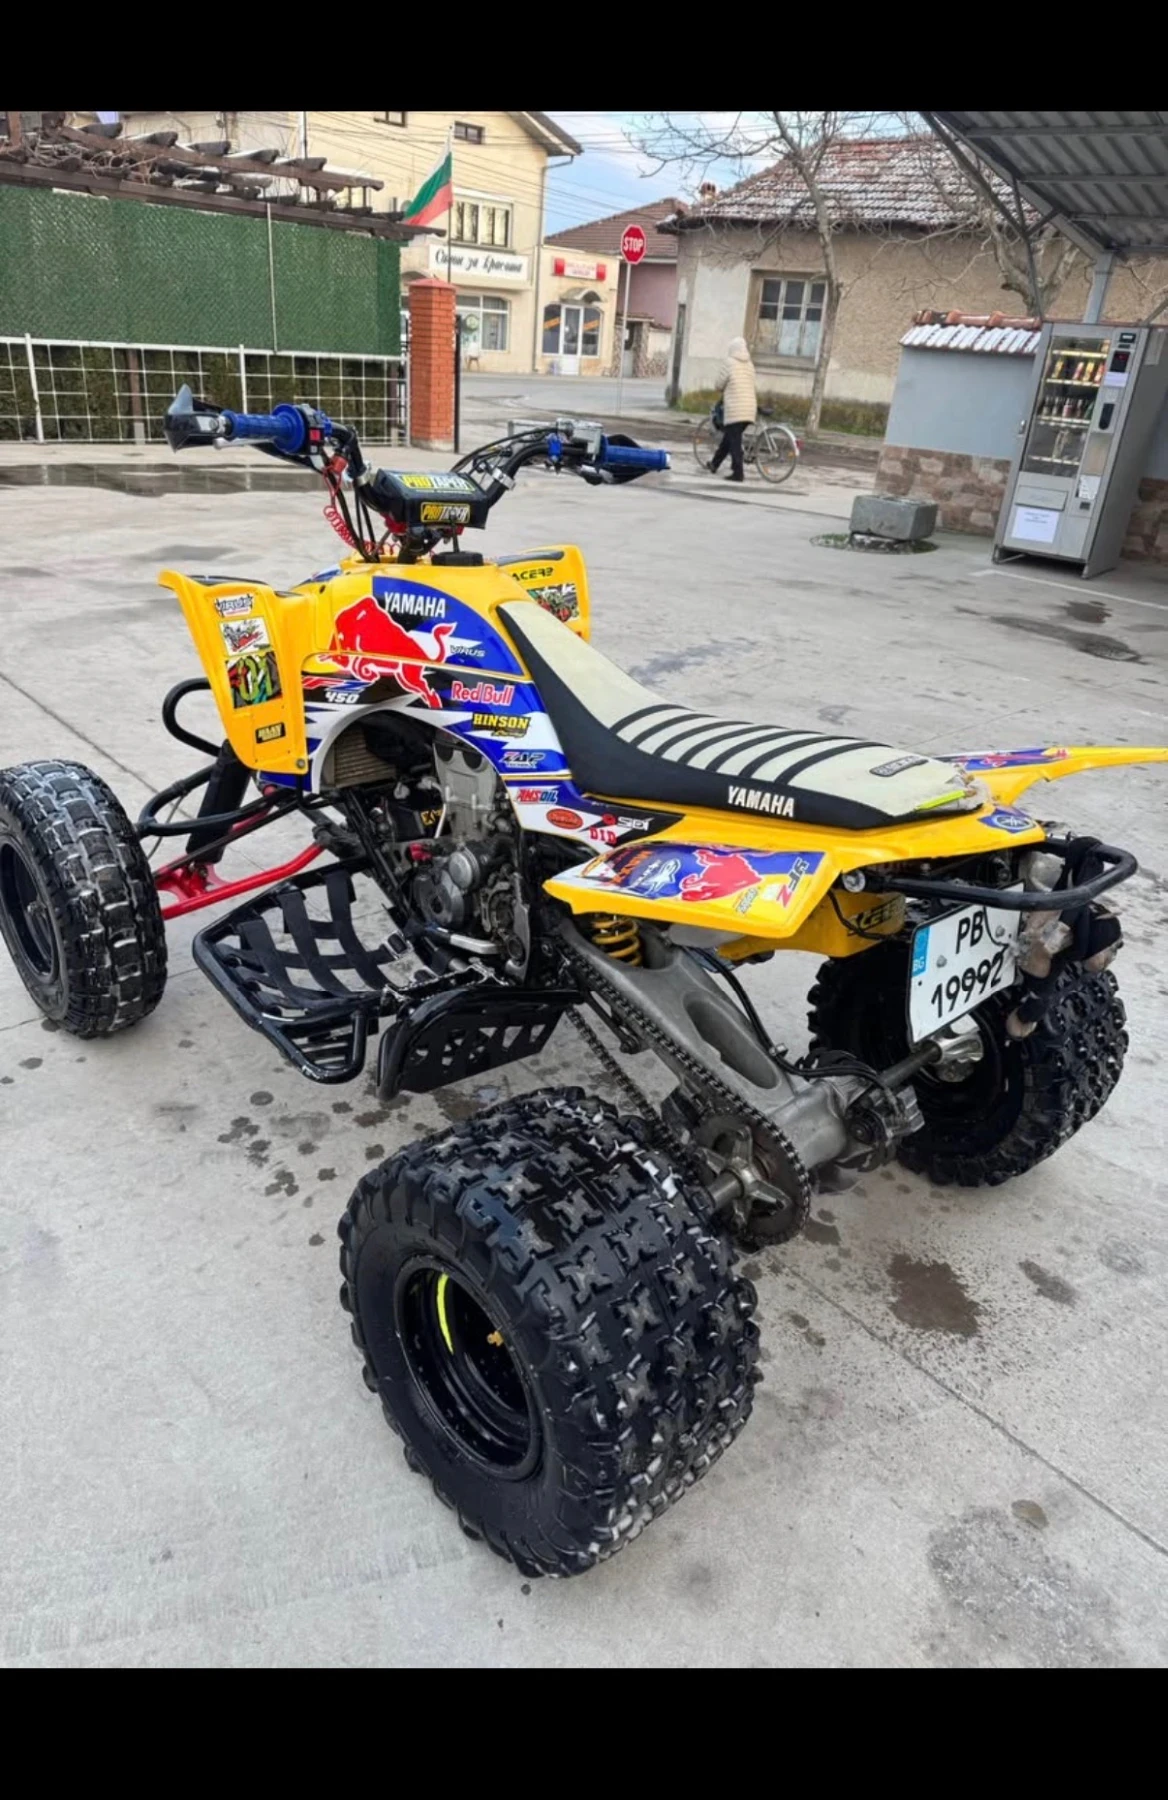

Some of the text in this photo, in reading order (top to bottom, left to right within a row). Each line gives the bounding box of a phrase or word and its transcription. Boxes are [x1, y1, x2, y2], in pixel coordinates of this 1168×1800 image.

[624, 237, 643, 252] STOP
[384, 592, 446, 618] YAMAHA
[325, 690, 359, 703] 450
[452, 681, 515, 706] Red Bull
[473, 713, 529, 729] HINSON
[517, 789, 558, 804] AMSOIL
[728, 785, 795, 817] YAMAHA
[589, 827, 618, 844] DID
[931, 951, 1005, 1018] 19992
